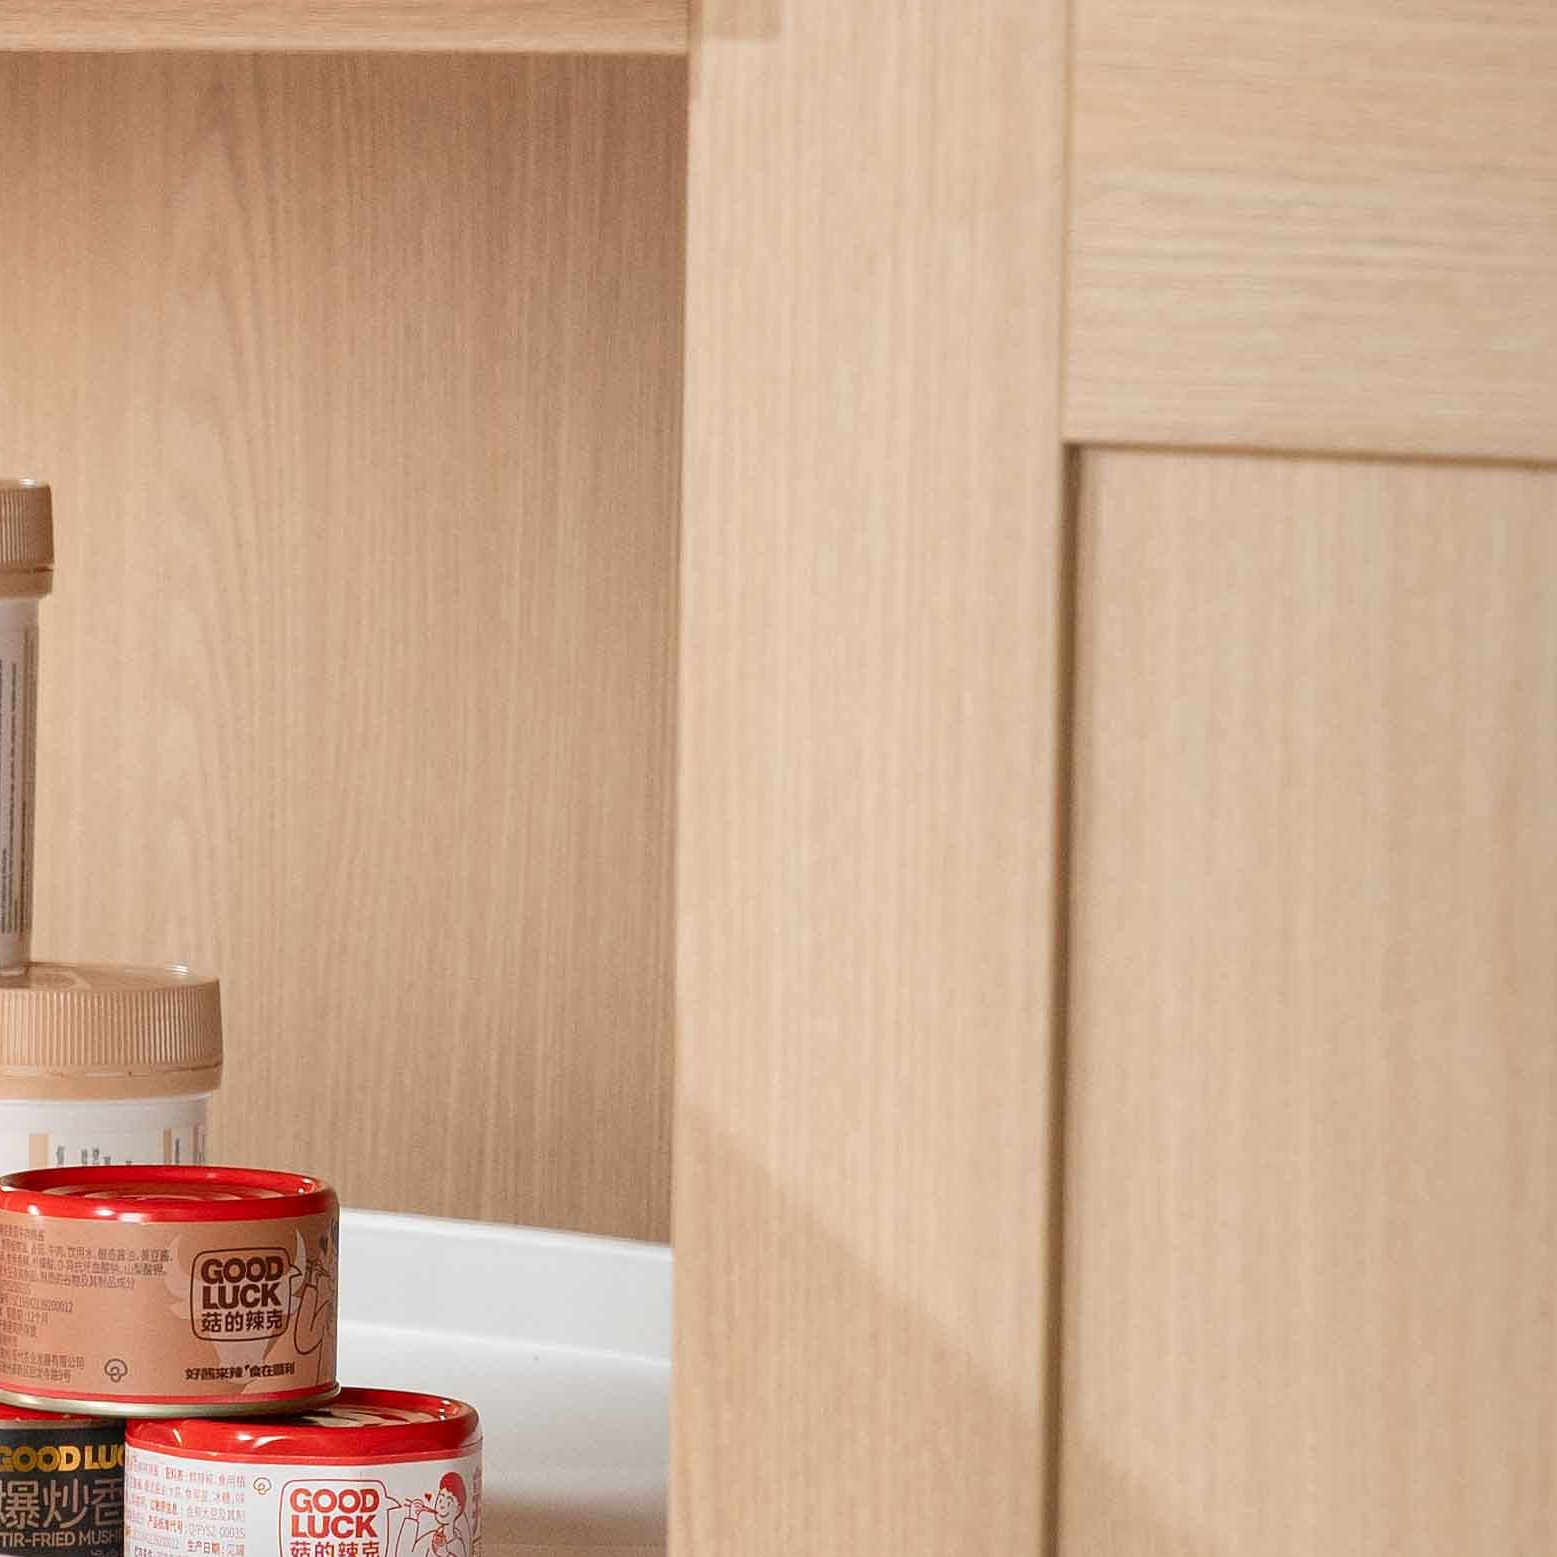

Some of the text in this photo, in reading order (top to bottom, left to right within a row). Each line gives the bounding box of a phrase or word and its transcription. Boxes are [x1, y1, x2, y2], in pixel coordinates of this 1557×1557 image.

[200, 1255, 285, 1285] GOOD
[202, 1282, 282, 1310] LUCK
[200, 1309, 284, 1333] 菇的辣克
[289, 1487, 381, 1515] GOOD
[290, 1513, 380, 1540] LUCK
